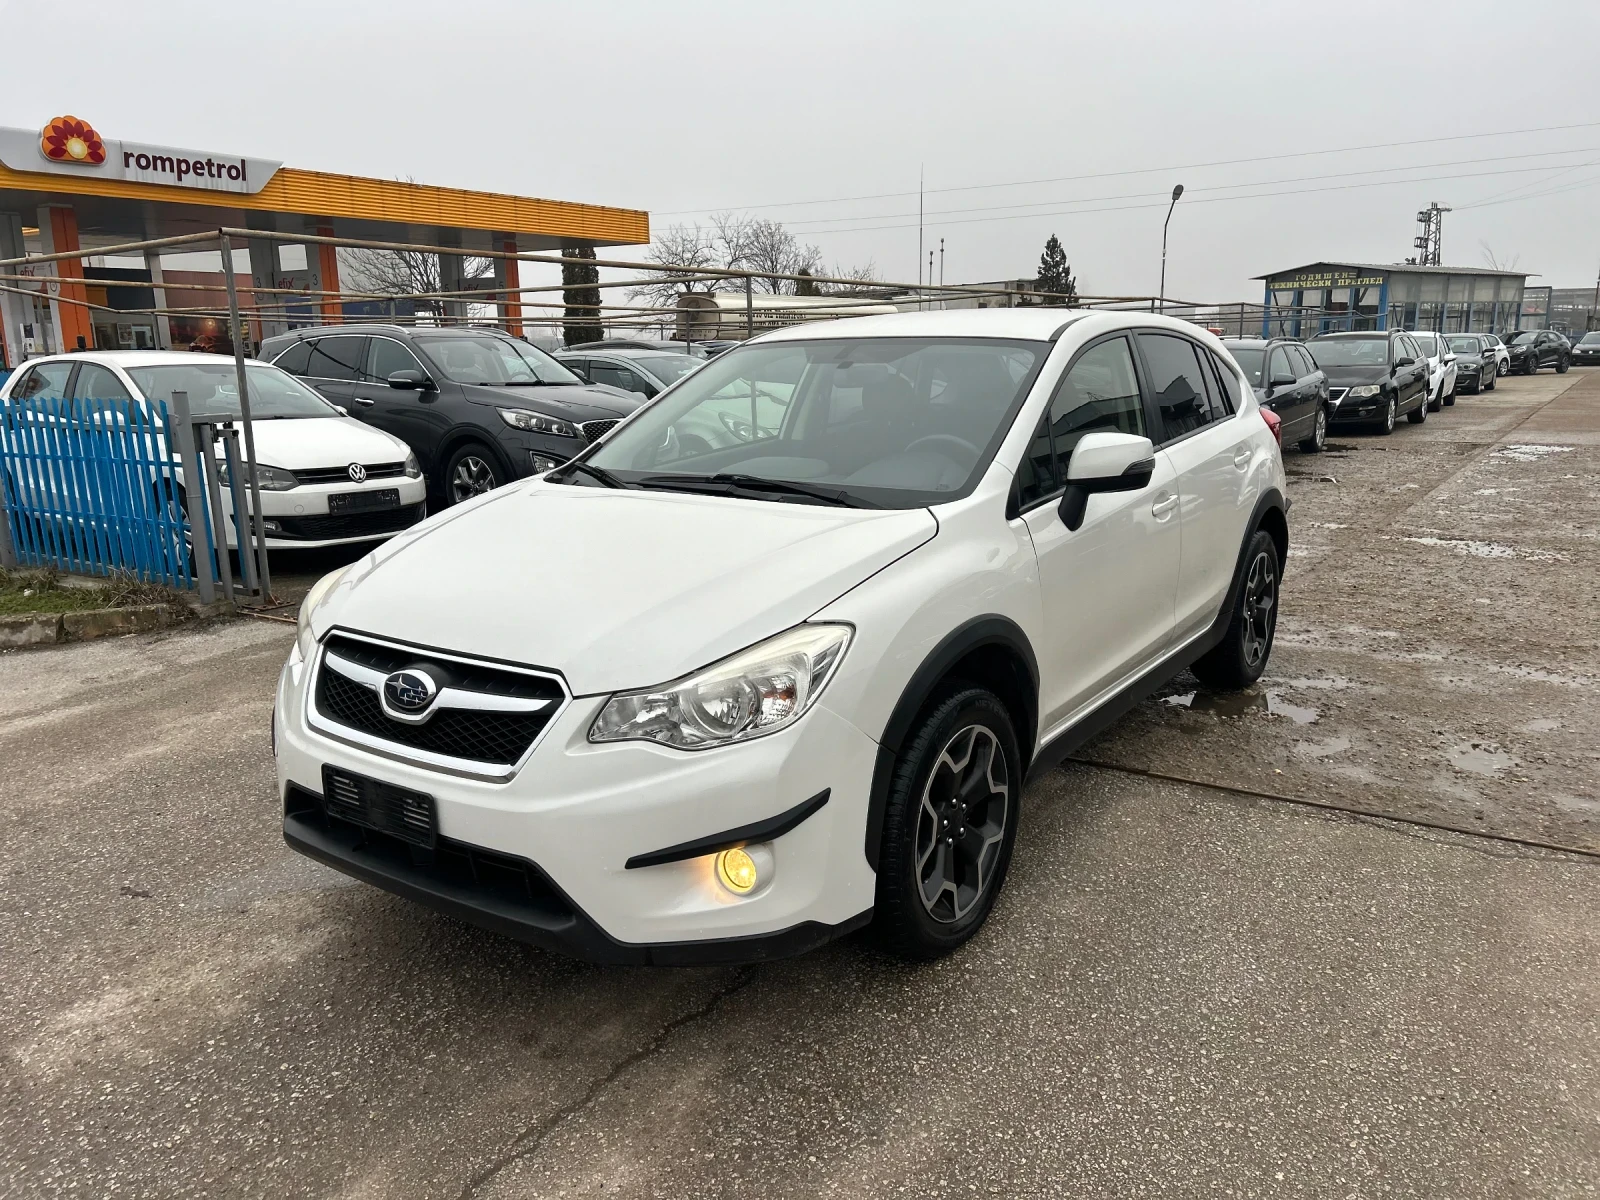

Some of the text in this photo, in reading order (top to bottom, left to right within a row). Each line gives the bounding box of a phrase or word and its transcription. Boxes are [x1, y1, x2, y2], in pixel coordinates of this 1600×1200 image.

[123, 151, 247, 181] rompetrol
[278, 277, 295, 289] efix
[312, 273, 319, 286] 3
[1269, 277, 1383, 288] ТЕХНИЧЕСКИ ПРЕГЛЕД
